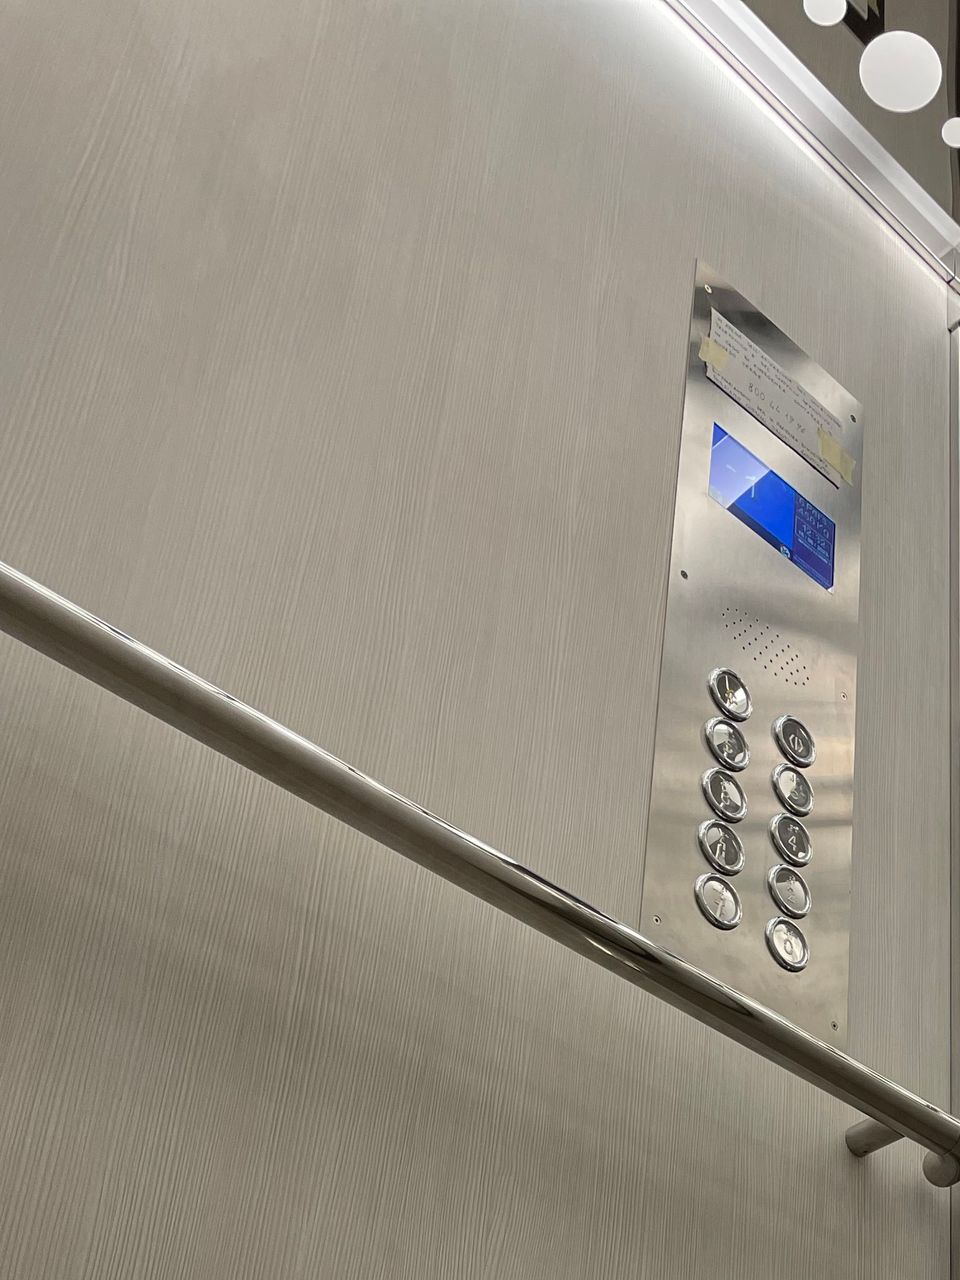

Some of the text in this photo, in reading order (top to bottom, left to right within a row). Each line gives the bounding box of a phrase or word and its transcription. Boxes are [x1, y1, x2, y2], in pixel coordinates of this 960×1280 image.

[748, 383, 765, 400] 800
[788, 834, 796, 851] 4
[783, 937, 792, 955] 0
